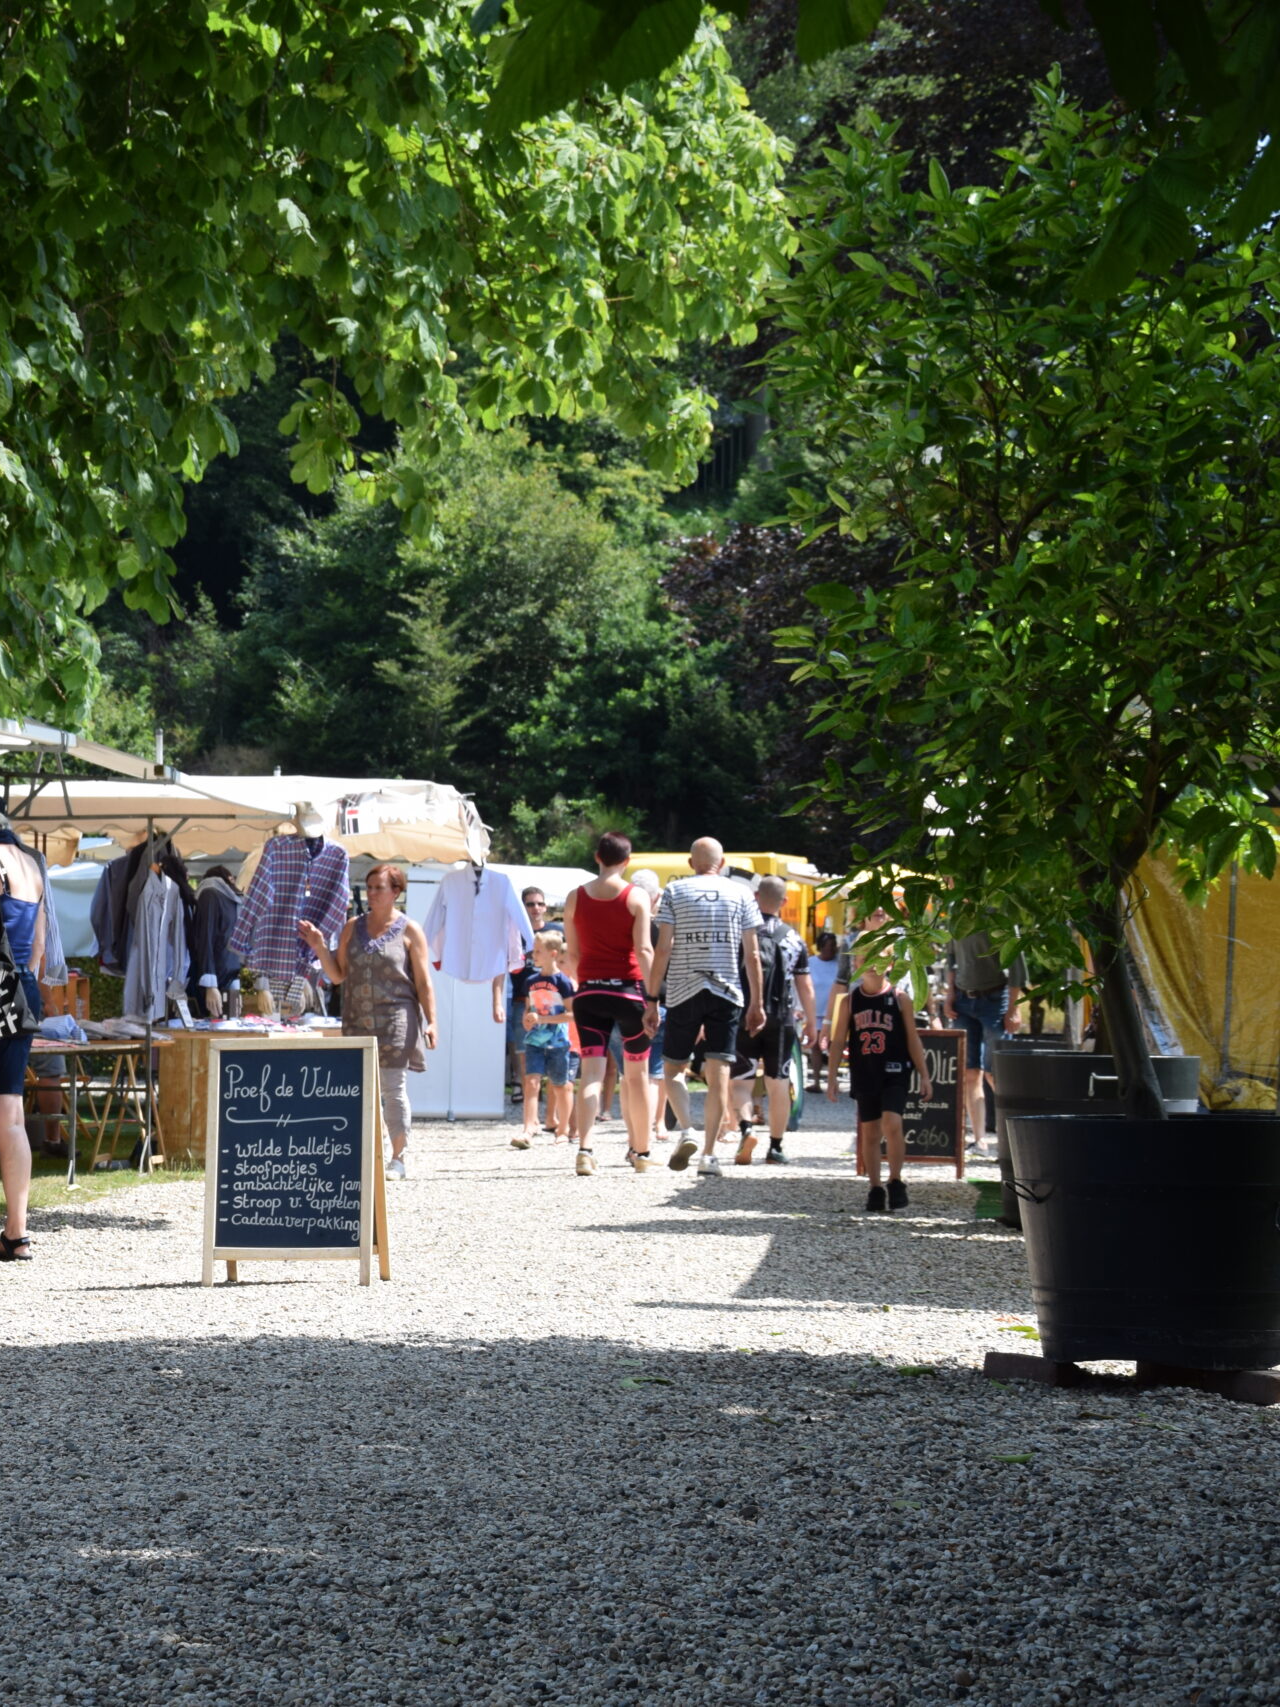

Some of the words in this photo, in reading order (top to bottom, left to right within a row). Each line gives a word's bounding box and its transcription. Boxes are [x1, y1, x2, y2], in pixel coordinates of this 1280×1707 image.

[685, 931, 732, 943] REFILL
[859, 1031, 886, 1055] 23
[224, 1064, 271, 1113] Proef
[275, 1073, 294, 1098] de
[300, 1066, 361, 1098] Veluwe
[234, 1138, 282, 1158] wilde
[288, 1135, 352, 1165] balletjes
[233, 1159, 318, 1181] stoofpotjes
[336, 1174, 361, 1200] jam
[289, 1197, 302, 1208] v.
[310, 1196, 361, 1214] appelen
